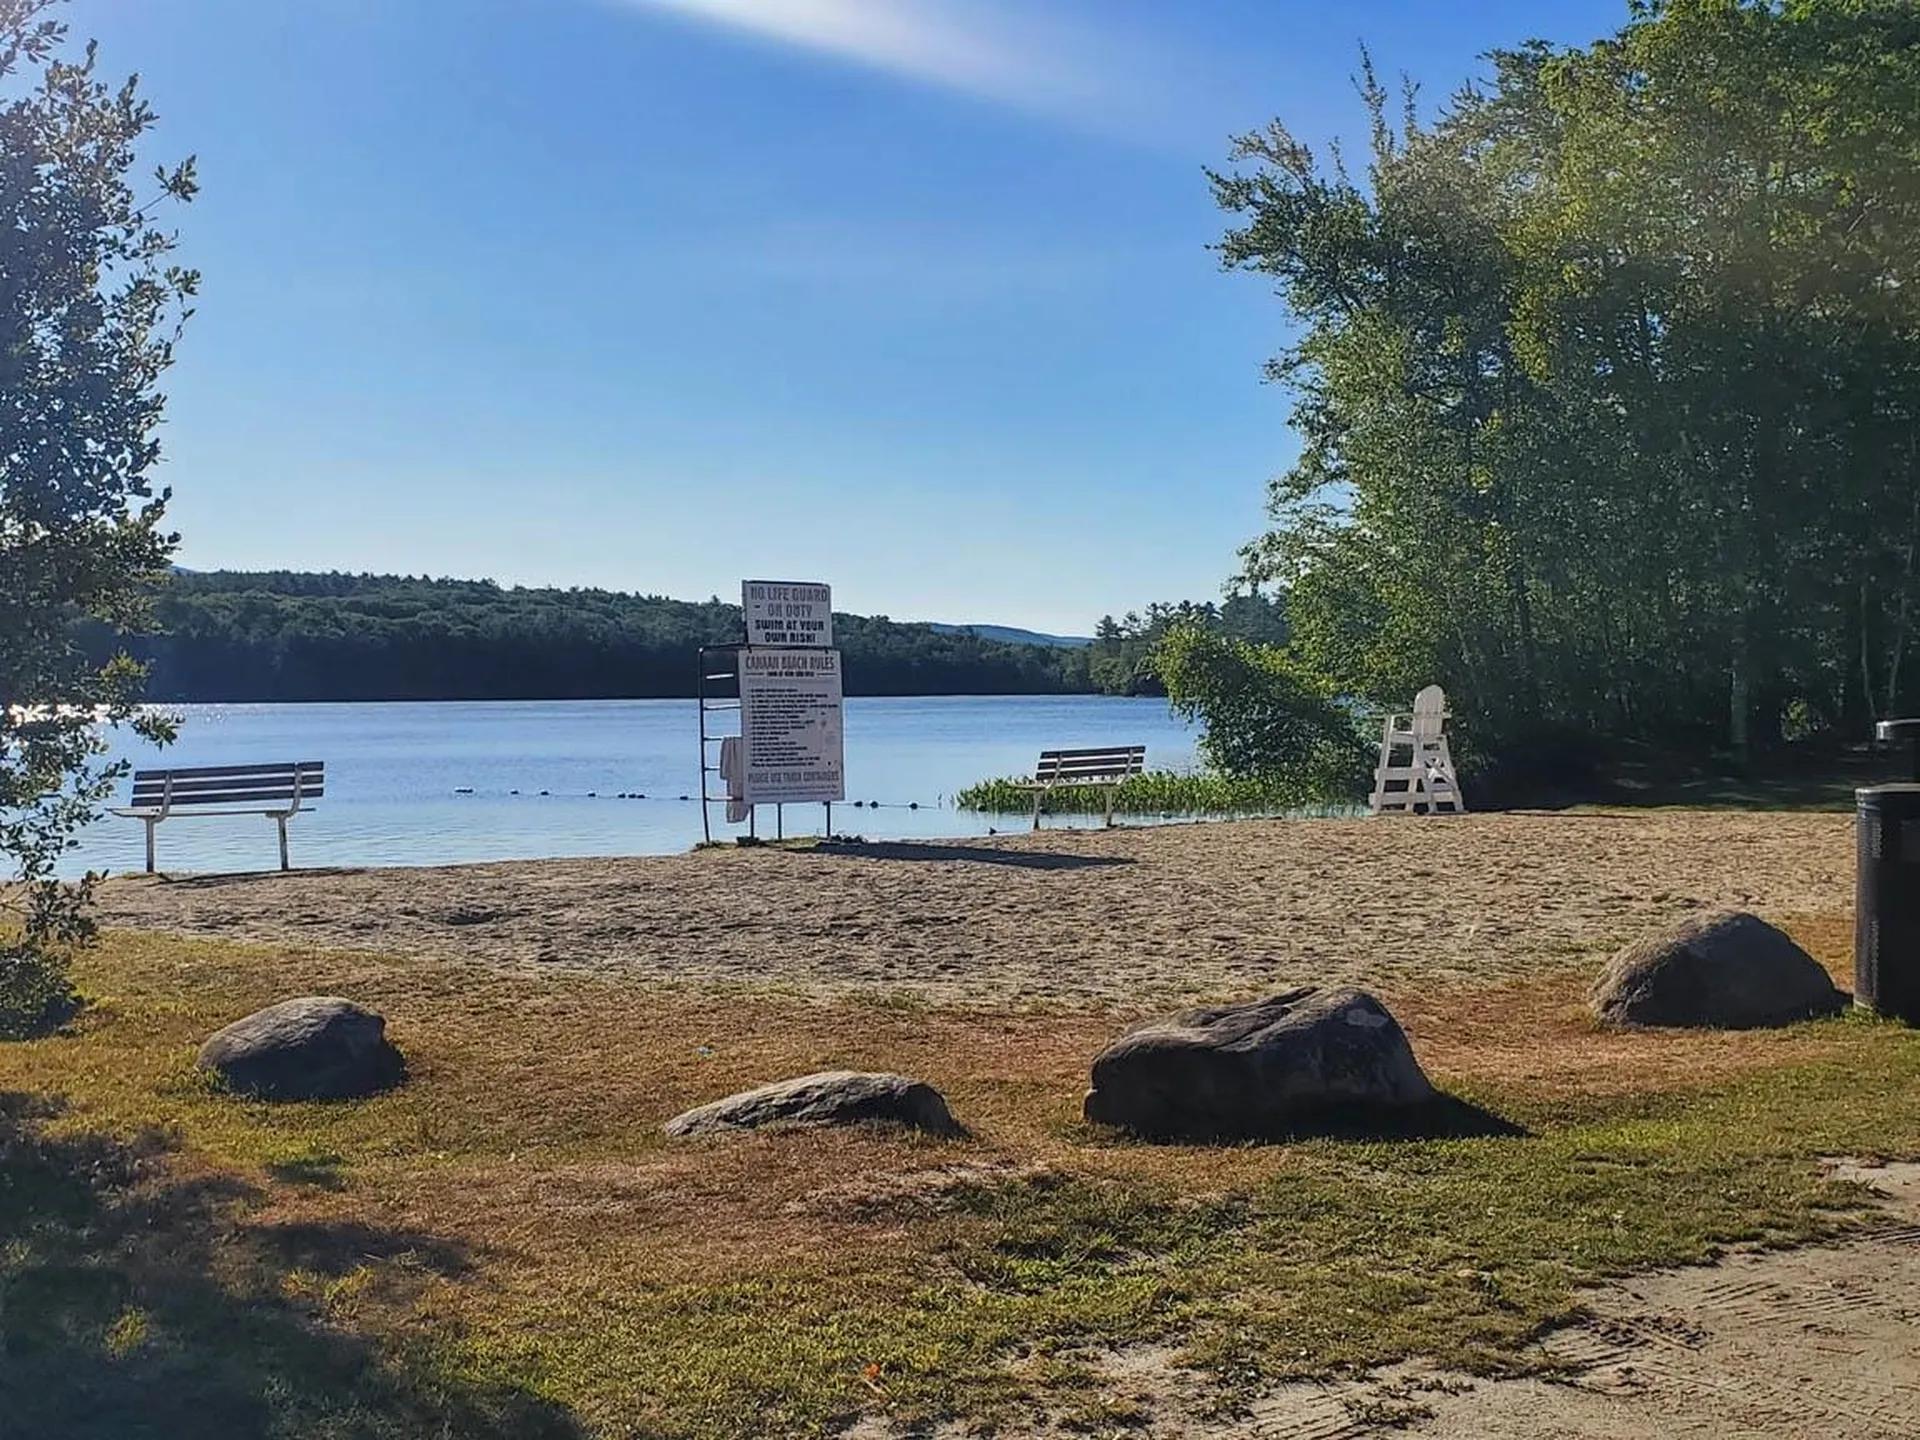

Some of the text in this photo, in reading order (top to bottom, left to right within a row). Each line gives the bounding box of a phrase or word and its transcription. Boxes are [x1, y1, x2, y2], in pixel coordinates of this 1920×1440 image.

[751, 586, 828, 602] NO LIFE GUARD
[768, 603, 812, 617] ON DUTY
[755, 620, 824, 631] SWIM AT YOUR
[764, 632, 787, 643] OWN
[810, 657, 834, 670] RULES
